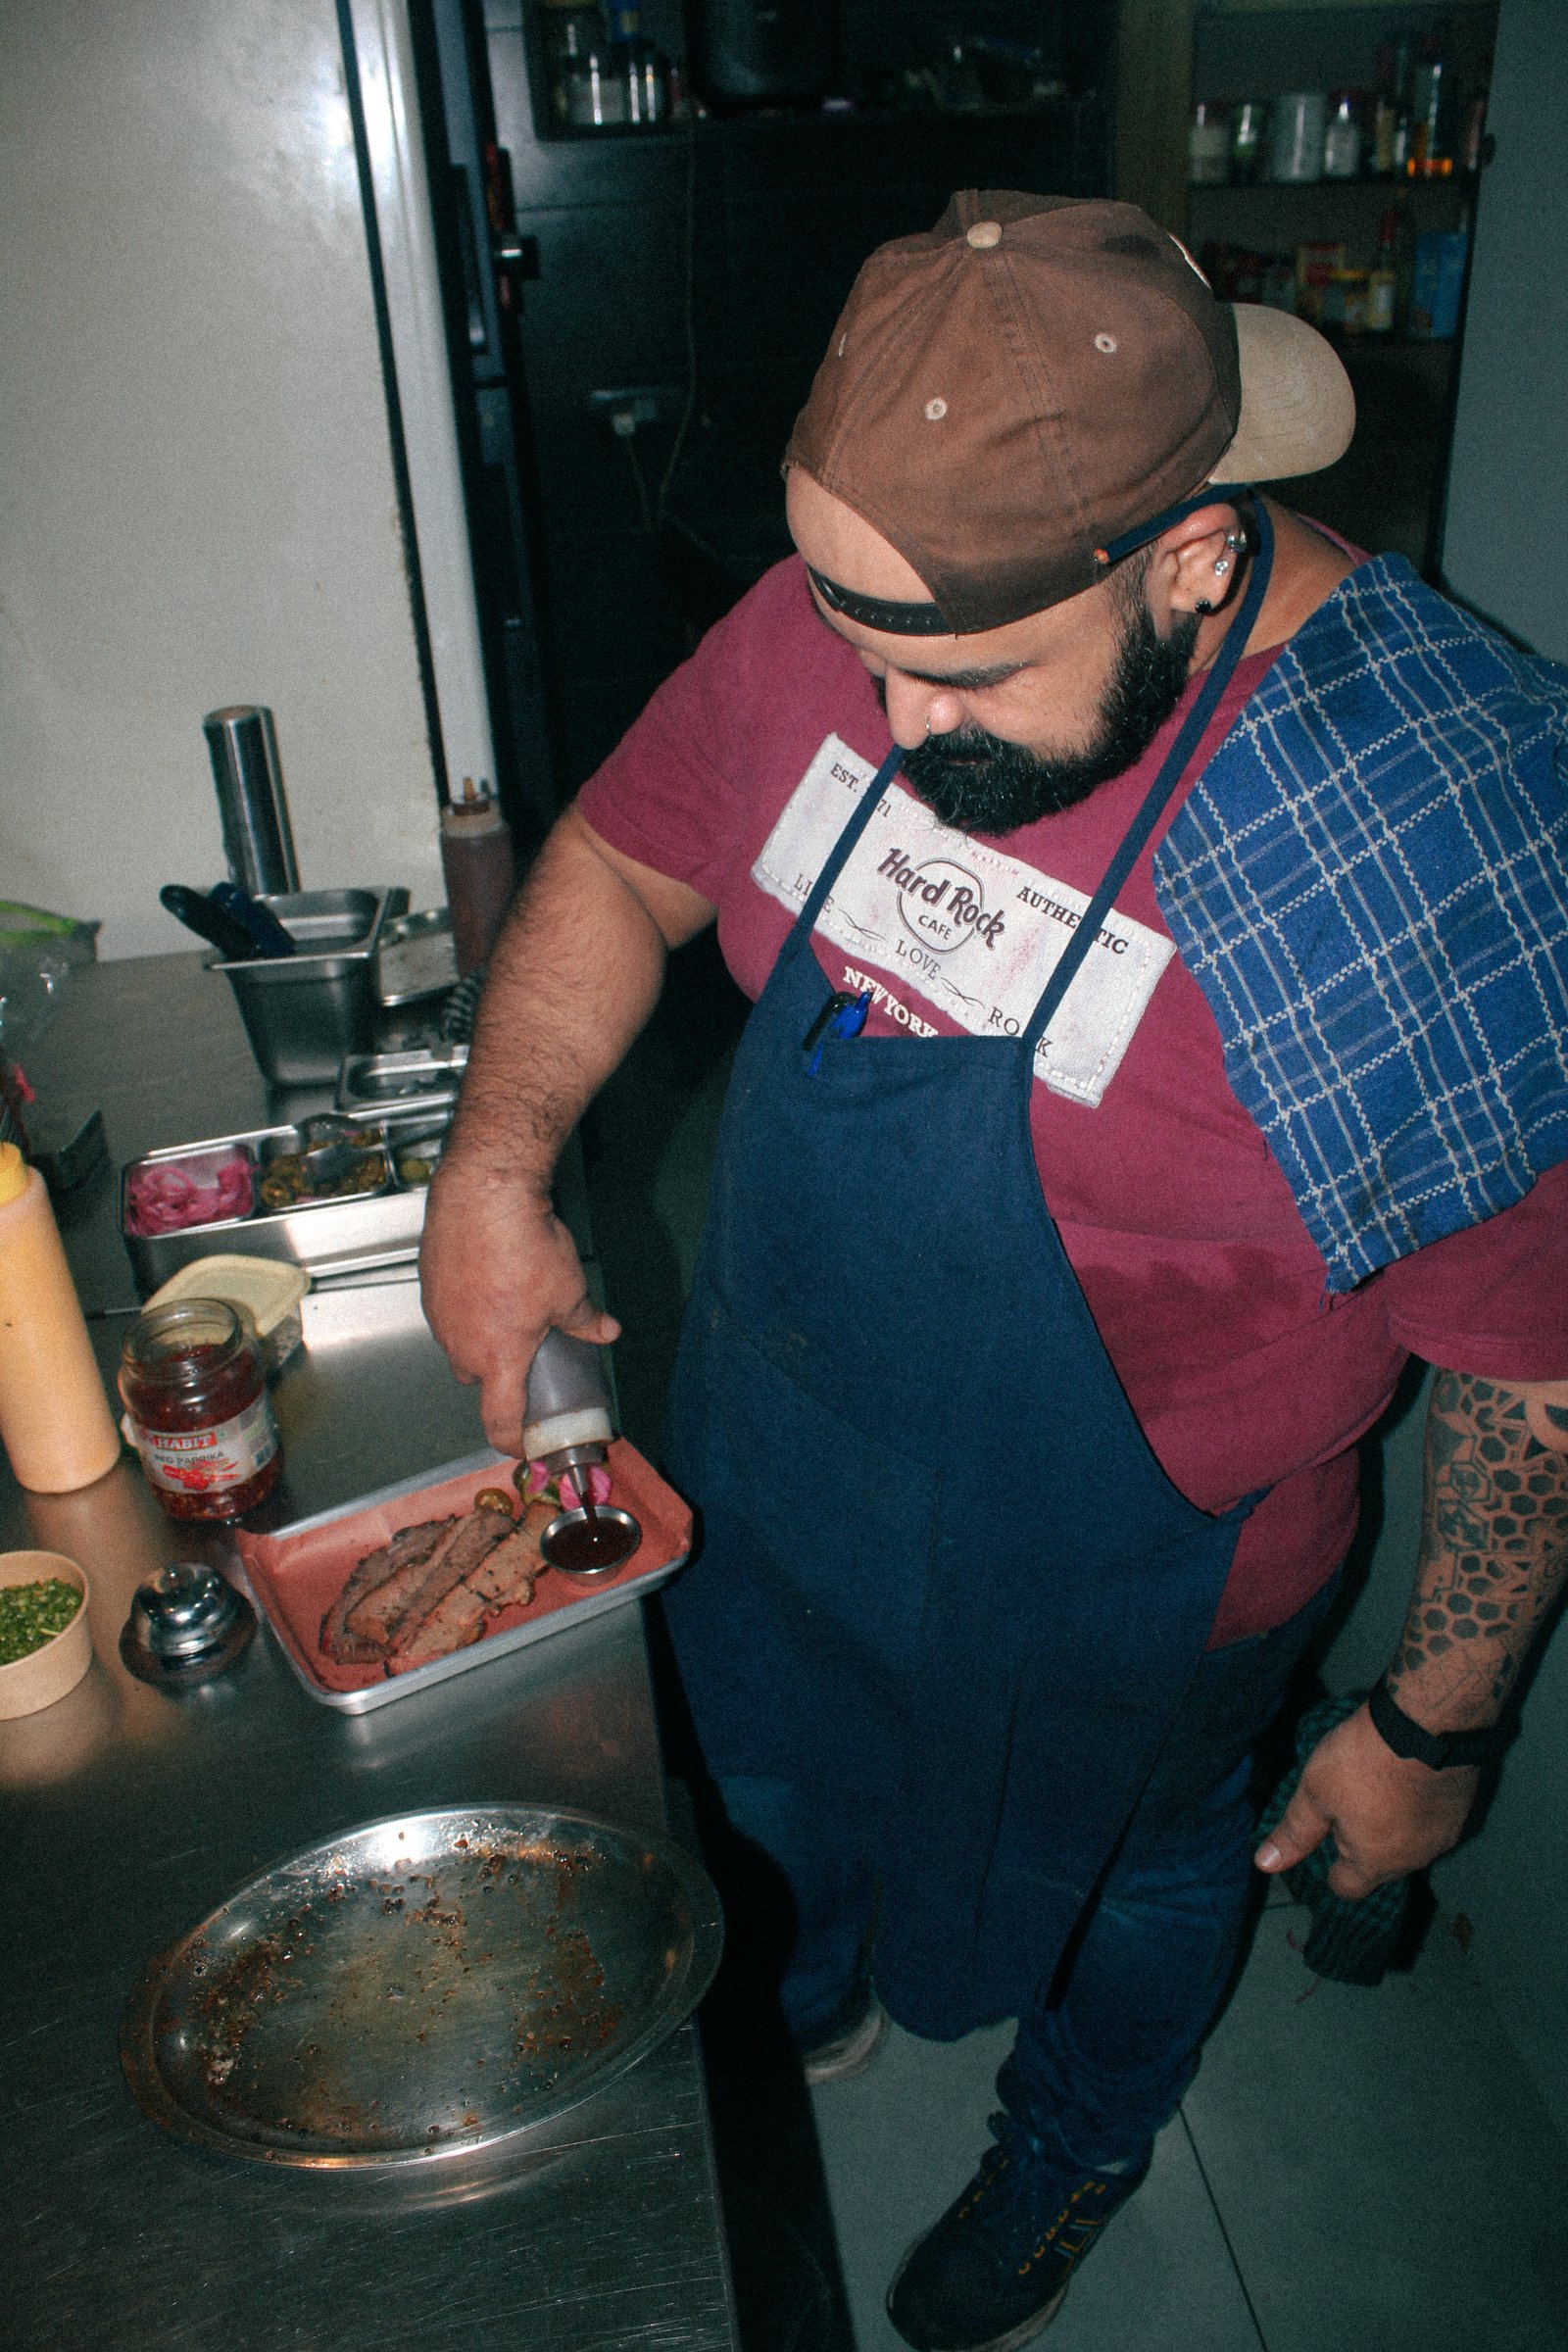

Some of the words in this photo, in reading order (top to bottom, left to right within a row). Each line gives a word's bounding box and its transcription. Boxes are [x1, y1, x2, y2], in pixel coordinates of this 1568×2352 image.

[830, 762, 858, 793] EST.
[877, 848, 952, 906] Hard
[946, 886, 1005, 951] Rock
[1016, 886, 1129, 955] AUTHETIC
[918, 914, 953, 940] CAFE
[793, 872, 835, 914] LIE
[895, 940, 941, 980] LOVE
[988, 1006, 1053, 1057] ROK
[157, 1435, 211, 1449] HABIT
